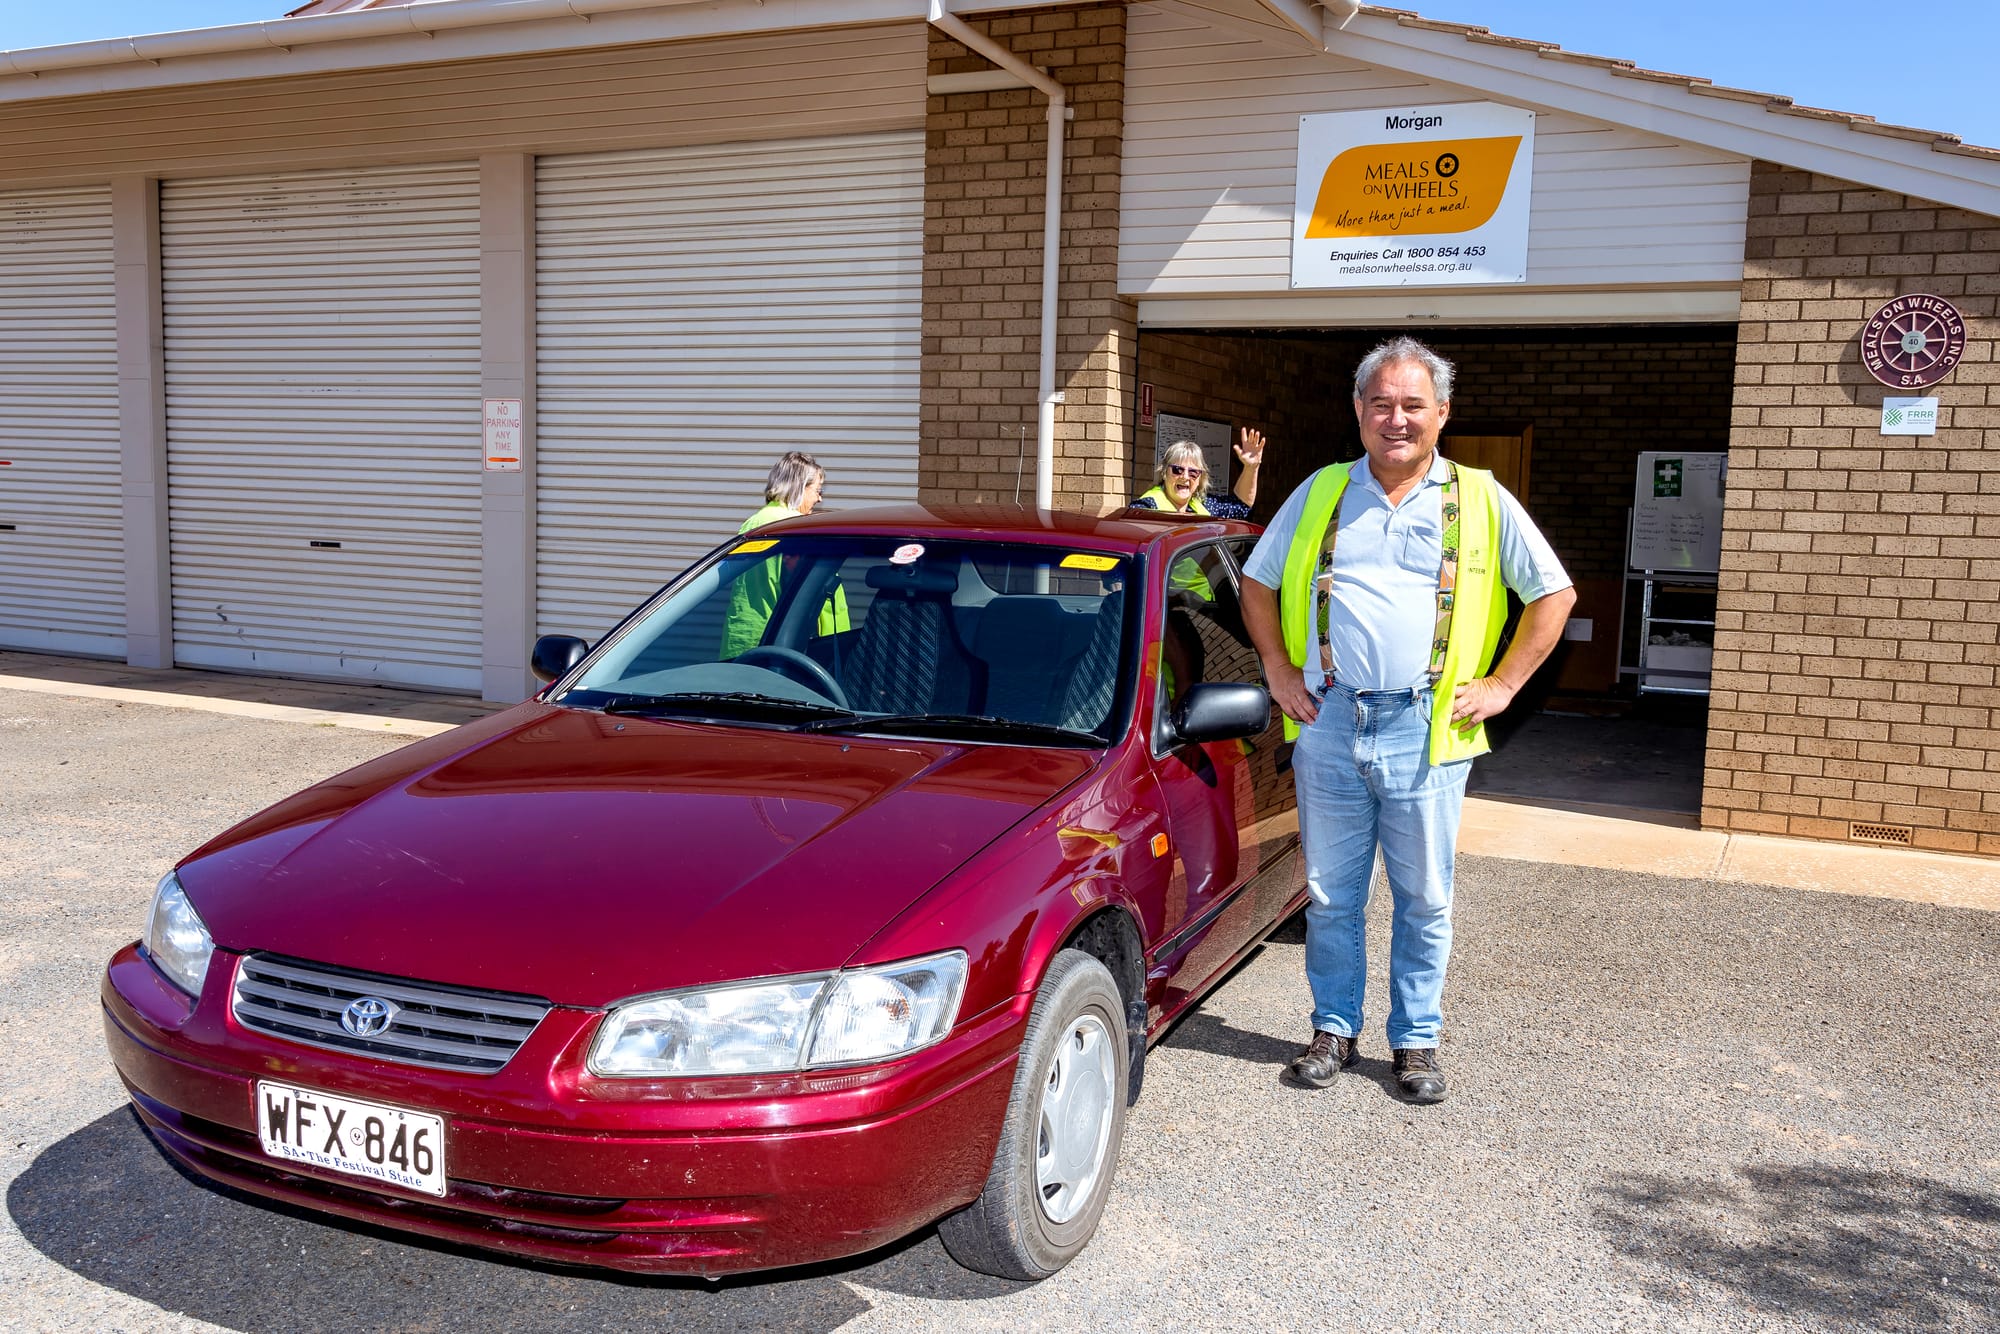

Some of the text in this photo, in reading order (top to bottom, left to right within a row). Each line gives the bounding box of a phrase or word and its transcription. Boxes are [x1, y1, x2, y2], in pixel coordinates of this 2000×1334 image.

[1385, 115, 1442, 130] Morgan
[1364, 160, 1429, 181] MEALS
[1363, 180, 1459, 199] ON WHEELS
[1335, 196, 1470, 230] More than just a meal.
[1330, 246, 1486, 262] Enquiries Call 1800 854 453
[1339, 261, 1472, 275] mealsonwheelssa.org.au
[1866, 297, 1962, 371] MEALS ON WHEELS INC.
[1908, 338, 1918, 346] 40
[1900, 374, 1927, 386] S.A.
[497, 405, 509, 415] NO
[1907, 410, 1934, 418] FRRR
[486, 418, 520, 428] PARKING
[495, 431, 511, 439] ANY
[495, 442, 512, 451] TIME
[266, 1092, 433, 1176] WFX 846
[333, 1156, 385, 1177] Festival
[388, 1169, 422, 1187] State
